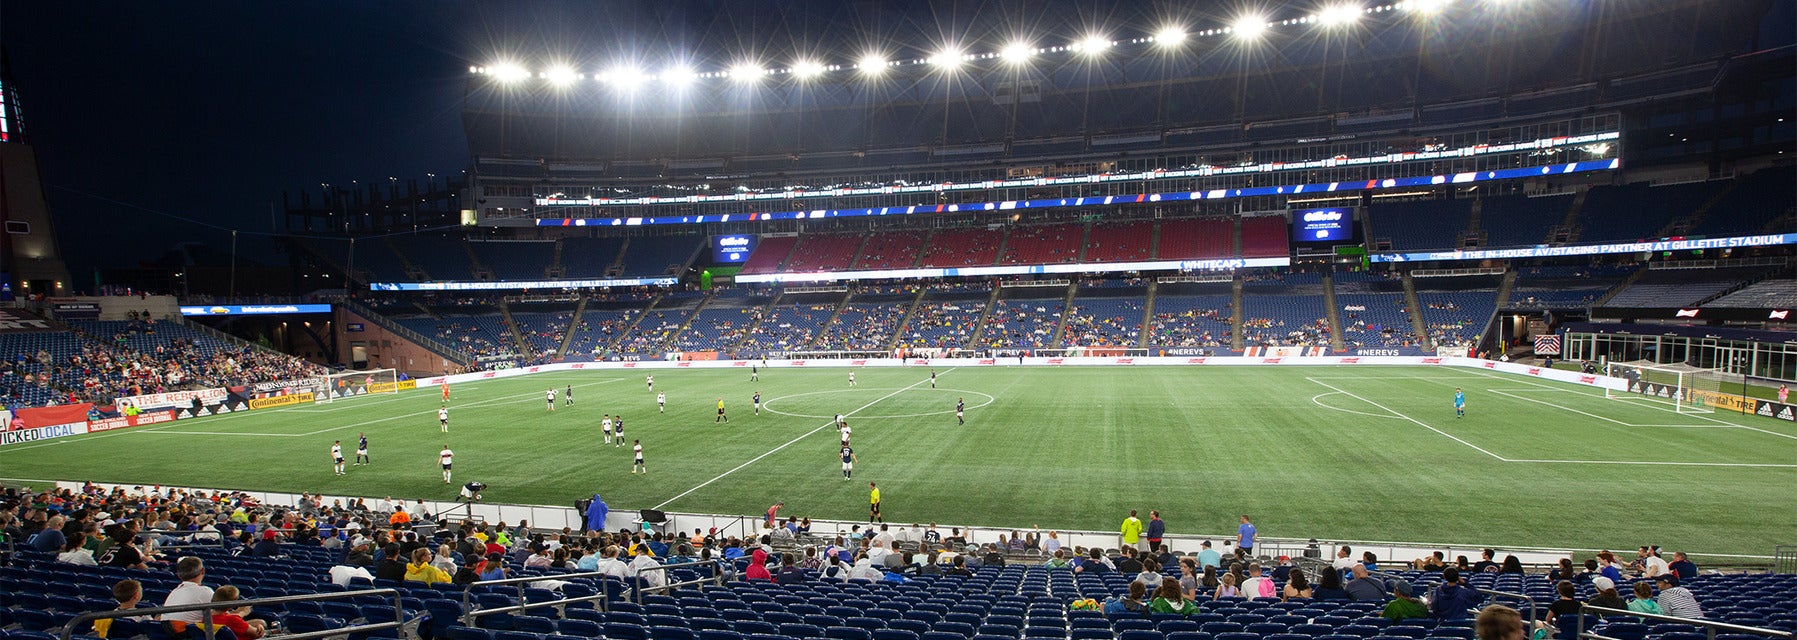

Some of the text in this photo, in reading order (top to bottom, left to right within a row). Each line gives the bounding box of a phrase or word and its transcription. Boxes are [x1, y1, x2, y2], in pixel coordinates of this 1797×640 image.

[1568, 135, 1596, 144] BACKING
[1598, 132, 1619, 140] DOWN
[1486, 249, 1532, 258] IN-HOUSE
[1535, 246, 1598, 256] AV/STAGING
[1601, 243, 1650, 253] PARTNER
[1654, 242, 1670, 250] AT
[1672, 239, 1726, 250] GILLETTE
[1729, 235, 1783, 246] STADIUM
[1184, 260, 1242, 269] WHITECAPS
[136, 396, 160, 406] THE
[166, 389, 226, 402] REBELLION
[252, 394, 313, 408] Continental TIRE
[1736, 400, 1754, 410] TIRE
